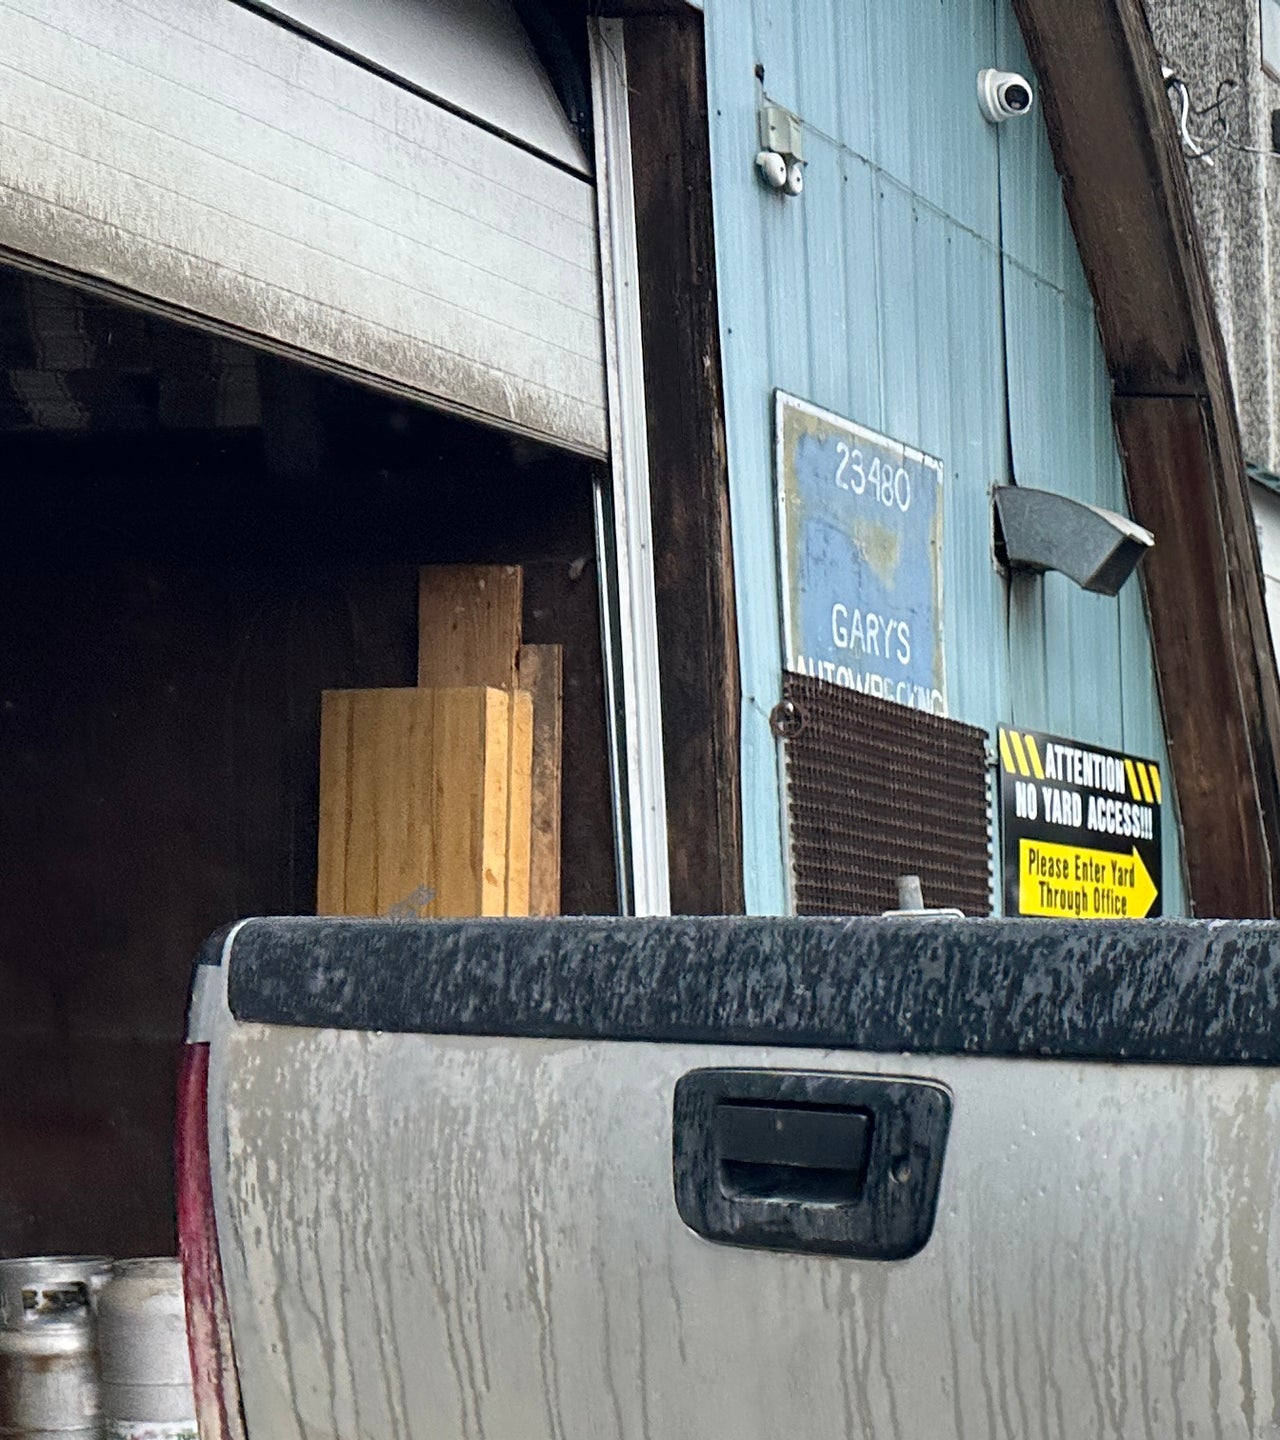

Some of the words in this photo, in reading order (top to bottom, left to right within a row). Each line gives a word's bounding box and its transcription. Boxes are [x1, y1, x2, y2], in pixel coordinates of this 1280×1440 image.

[835, 441, 911, 512] 23480
[832, 603, 911, 665] GARY'S
[1045, 742, 1126, 794] ATTENTION
[1015, 781, 1037, 820] NO
[1041, 786, 1082, 827] YARD
[1087, 795, 1153, 841] ACCESS!!!
[1028, 848, 1070, 880] Please
[1075, 854, 1106, 886] Enter
[1111, 860, 1135, 888] Yard
[1039, 881, 1088, 915] Through
[1093, 887, 1127, 916] Office
